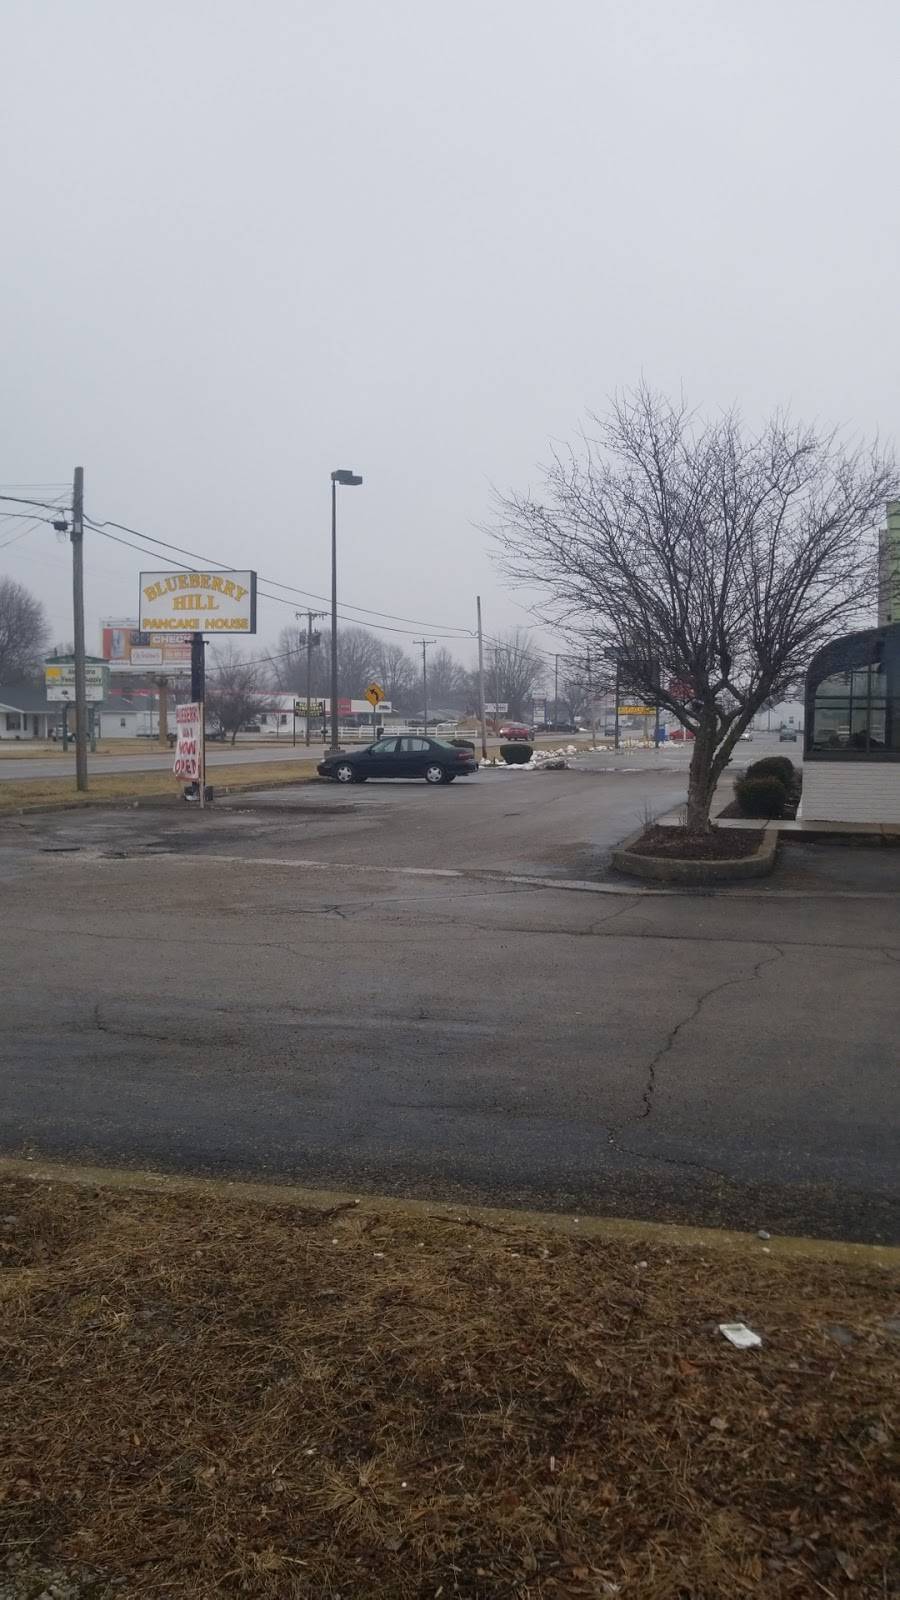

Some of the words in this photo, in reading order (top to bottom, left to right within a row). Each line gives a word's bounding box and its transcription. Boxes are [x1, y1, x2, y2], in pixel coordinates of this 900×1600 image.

[143, 573, 249, 602] BLUEBERRY
[172, 594, 219, 610] HILL
[143, 618, 200, 630] PANCAKE
[205, 618, 249, 630] HOUSE
